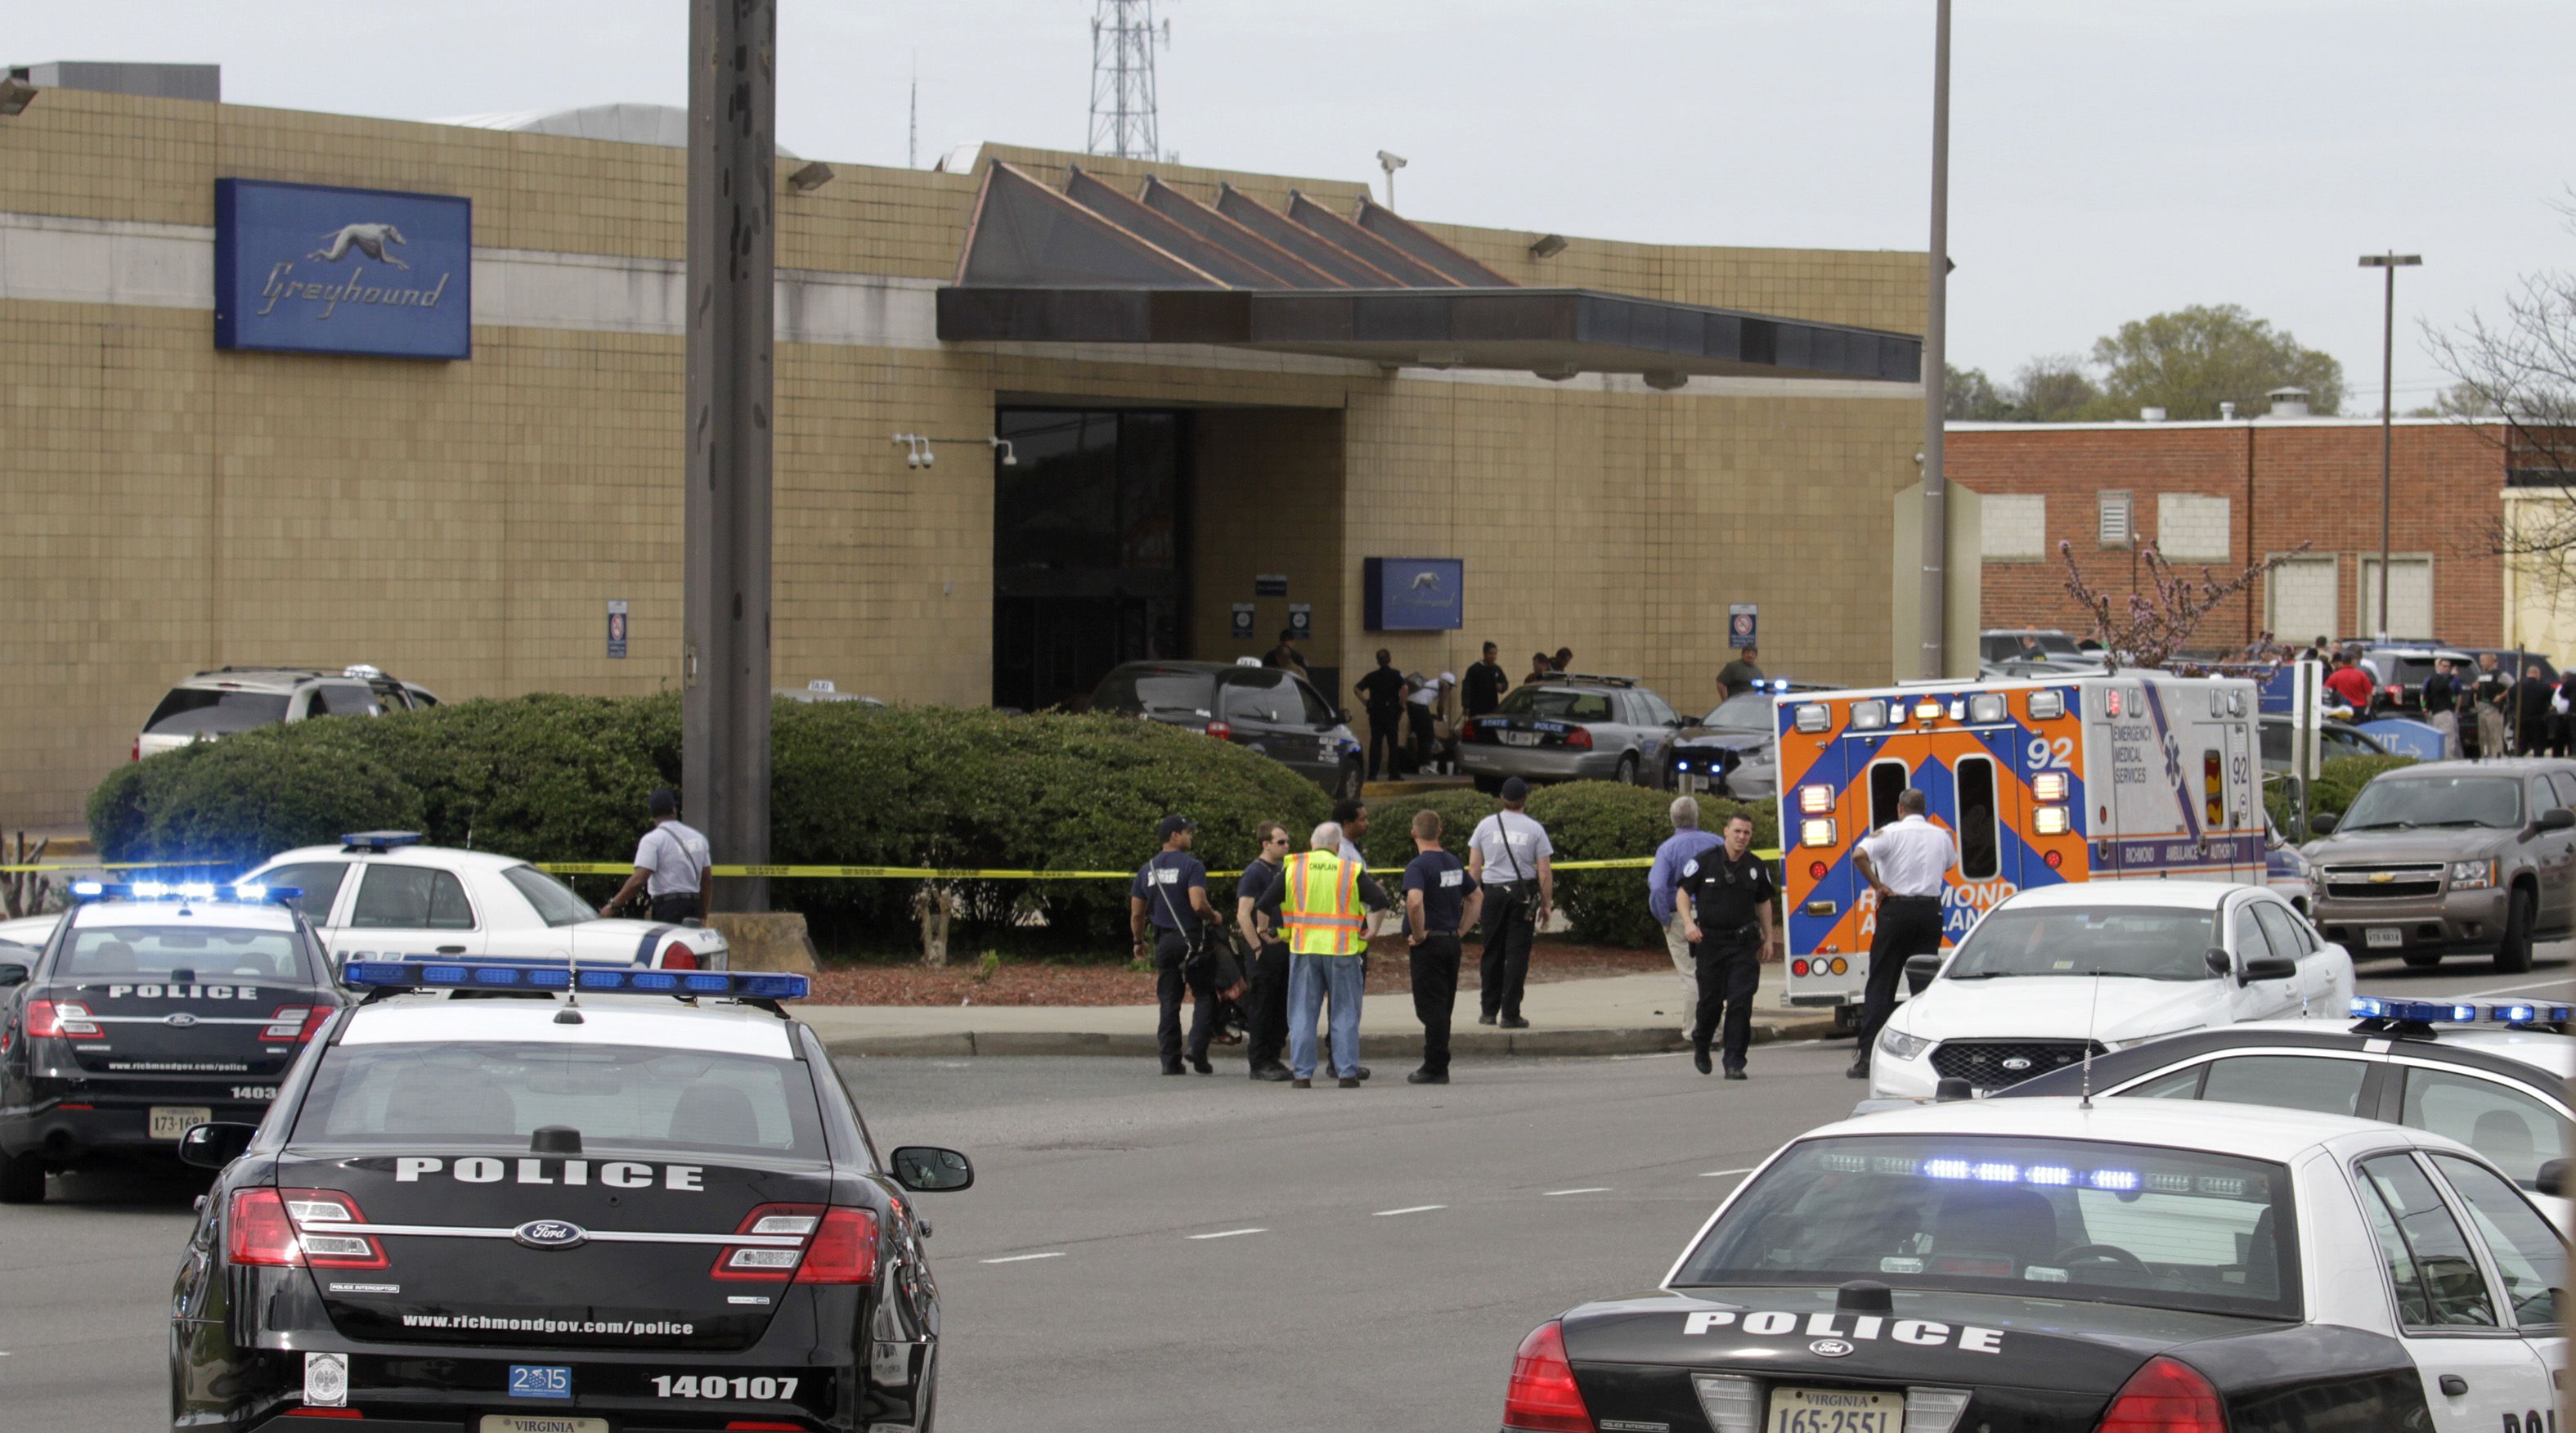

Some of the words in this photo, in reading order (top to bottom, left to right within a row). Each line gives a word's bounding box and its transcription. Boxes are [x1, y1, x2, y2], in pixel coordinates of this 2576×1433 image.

[257, 261, 450, 319] Greyhound
[1481, 719, 1507, 727] STATE
[1533, 722, 1564, 732] POLICE
[2113, 725, 2152, 742] EMERGENCY
[2369, 733, 2400, 752] XIT
[2026, 737, 2074, 770] 92
[2114, 747, 2143, 762] MEDICAL
[2116, 767, 2147, 783] SERVICES
[2233, 756, 2247, 785] 92
[2125, 847, 2155, 864] RICHMOND
[2165, 844, 2199, 861] AMBULANCE
[1308, 863, 1338, 871] CHAPLAIN
[1859, 883, 2017, 912] RMOND
[109, 985, 258, 1000] POLICE
[109, 1062, 248, 1071] www.richmondgov.com/police
[231, 1086, 280, 1099] 1403
[396, 1157, 704, 1191] POLICE
[532, 1224, 568, 1239] Ford
[402, 1314, 693, 1336] www.richmondgov.com/police
[1683, 1310, 2004, 1354] POLICE
[1818, 1342, 1844, 1353] Ford
[651, 1375, 799, 1399] 140107
[1806, 1394, 1869, 1408] VIRGINIA
[514, 1420, 575, 1433] VIRGINIA
